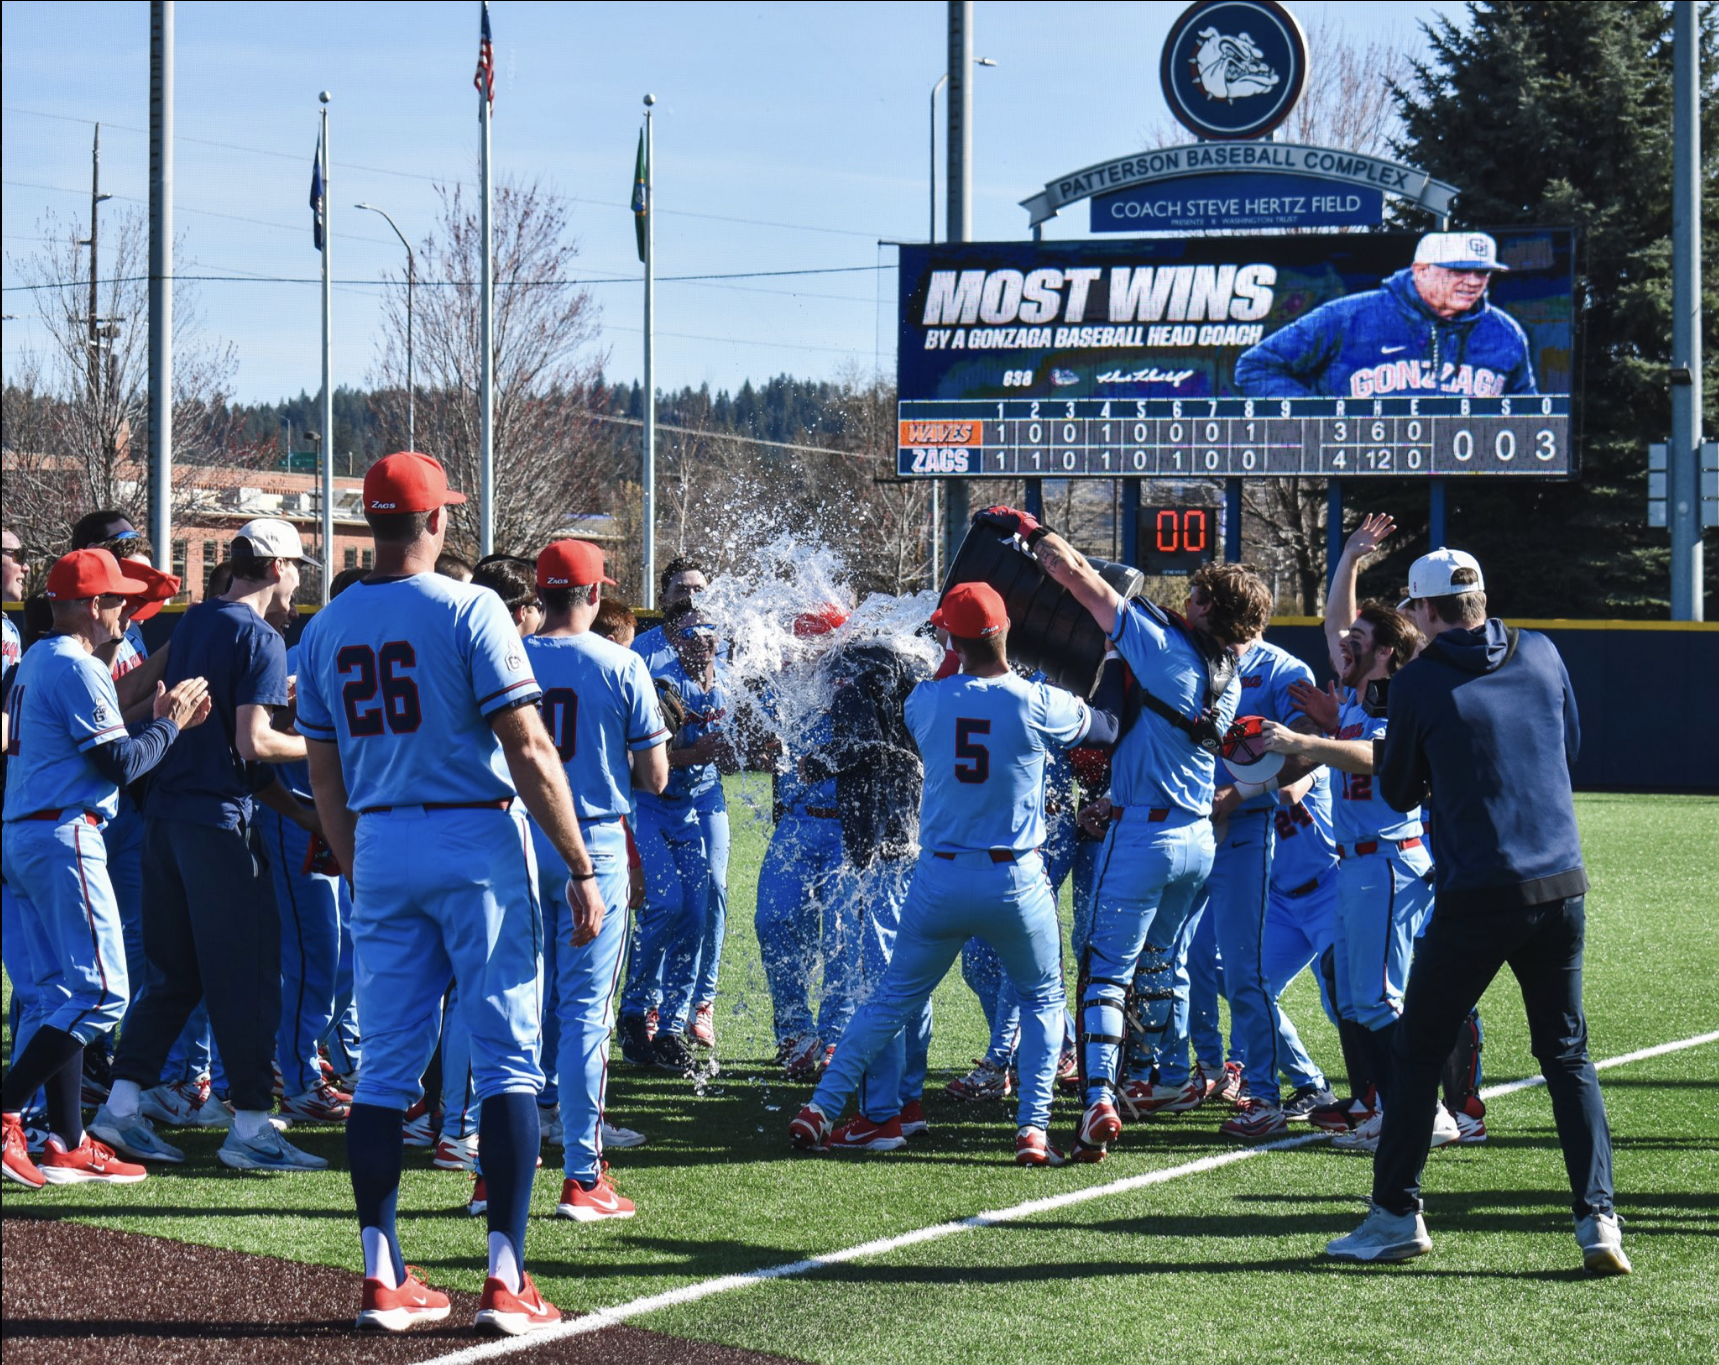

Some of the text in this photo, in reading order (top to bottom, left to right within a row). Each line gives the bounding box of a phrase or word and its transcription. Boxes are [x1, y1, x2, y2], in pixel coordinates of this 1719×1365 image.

[1059, 148, 1410, 200] PATTERSON BASEBALL COMPLEX
[1111, 195, 1361, 219] COACH STEVE HERTZ FIELD
[922, 264, 1278, 325] MOST WINS
[924, 324, 1264, 350] BY A GONZAGA BASEBALL HEAD COACH
[997, 402, 1004, 420] 1
[1030, 402, 1040, 420] 2
[1065, 401, 1075, 420] 3
[1100, 401, 1111, 418] 4
[1136, 401, 1146, 418] 5
[1172, 401, 1182, 418] 6
[1207, 400, 1217, 418] 7
[1245, 400, 1254, 418] 8
[1281, 400, 1291, 418] 9
[1336, 400, 1345, 417] R
[1373, 400, 1382, 416] H
[1410, 399, 1419, 416] E
[1461, 399, 1470, 415] B
[1501, 399, 1511, 415] S
[908, 421, 1421, 444] WAVES 1 0 0 1 0 0 0 1 3 6 0
[1453, 429, 1556, 461] 0 0 3
[911, 449, 1421, 473] ZAGS 1 1 0 1 0 1 0 0 4 12 0
[1156, 510, 1206, 552] 00
[337, 640, 423, 737] 26
[955, 717, 991, 784] 5
